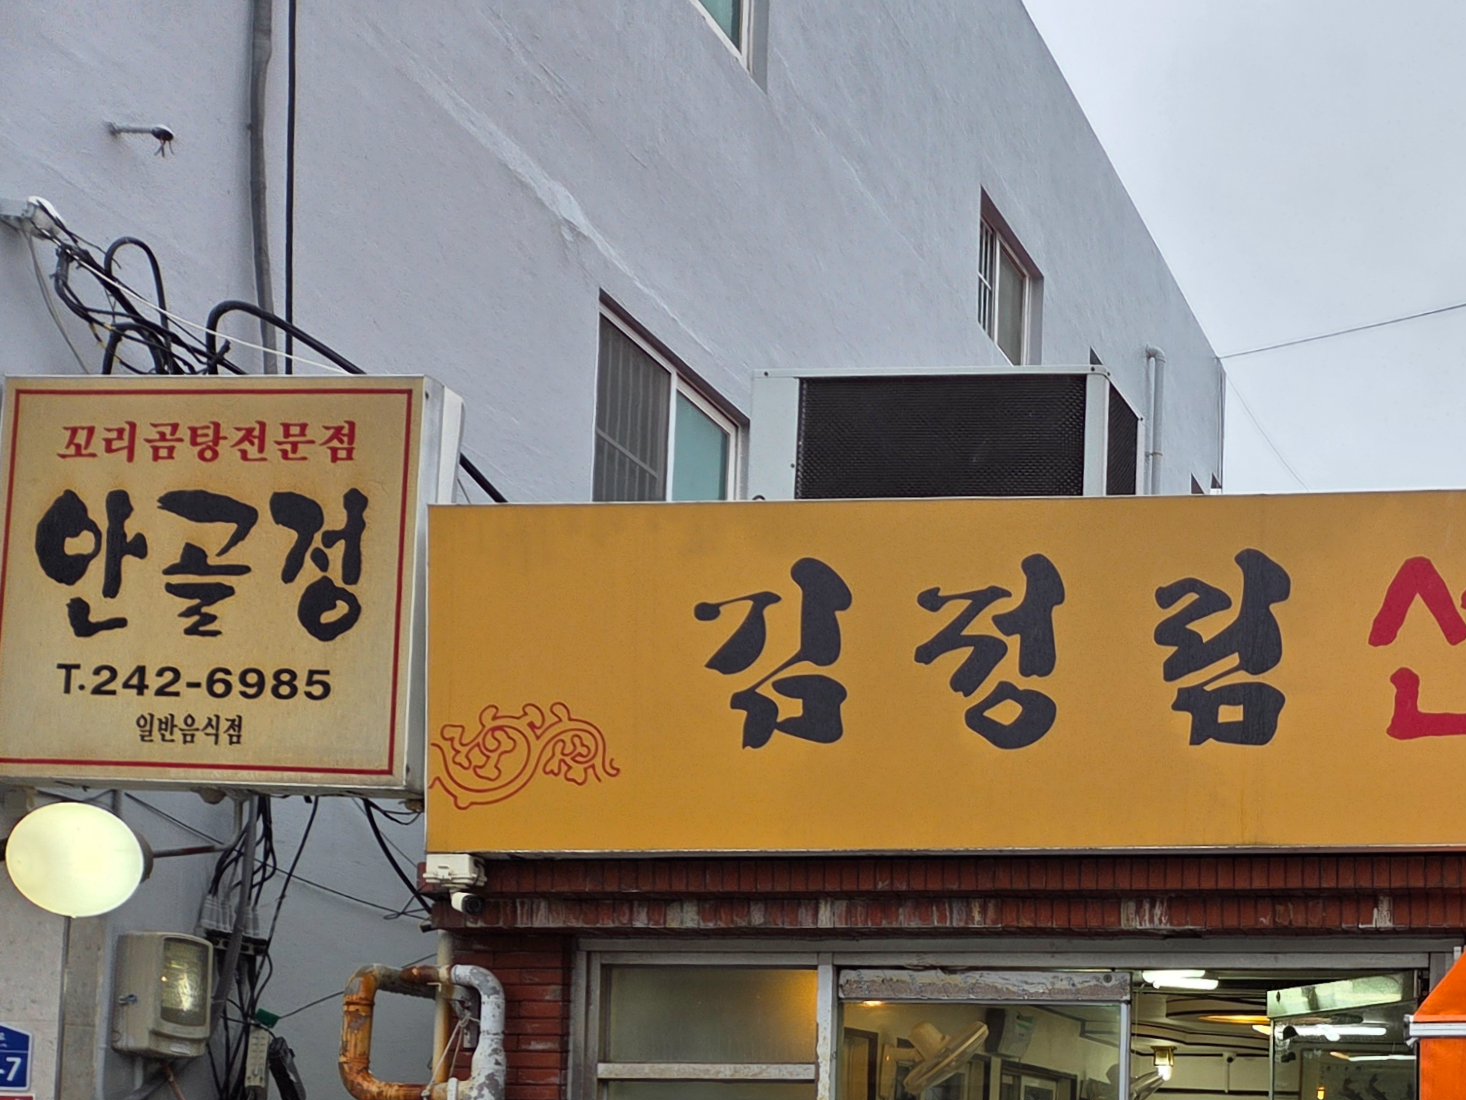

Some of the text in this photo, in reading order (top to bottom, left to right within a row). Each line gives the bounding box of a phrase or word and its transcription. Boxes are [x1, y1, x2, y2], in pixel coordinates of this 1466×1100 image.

[57, 421, 357, 463] 꼬리곰탕전문점
[35, 488, 369, 642] 안골정
[56, 662, 332, 701] T.242-6985
[136, 713, 243, 745] 일반음식점
